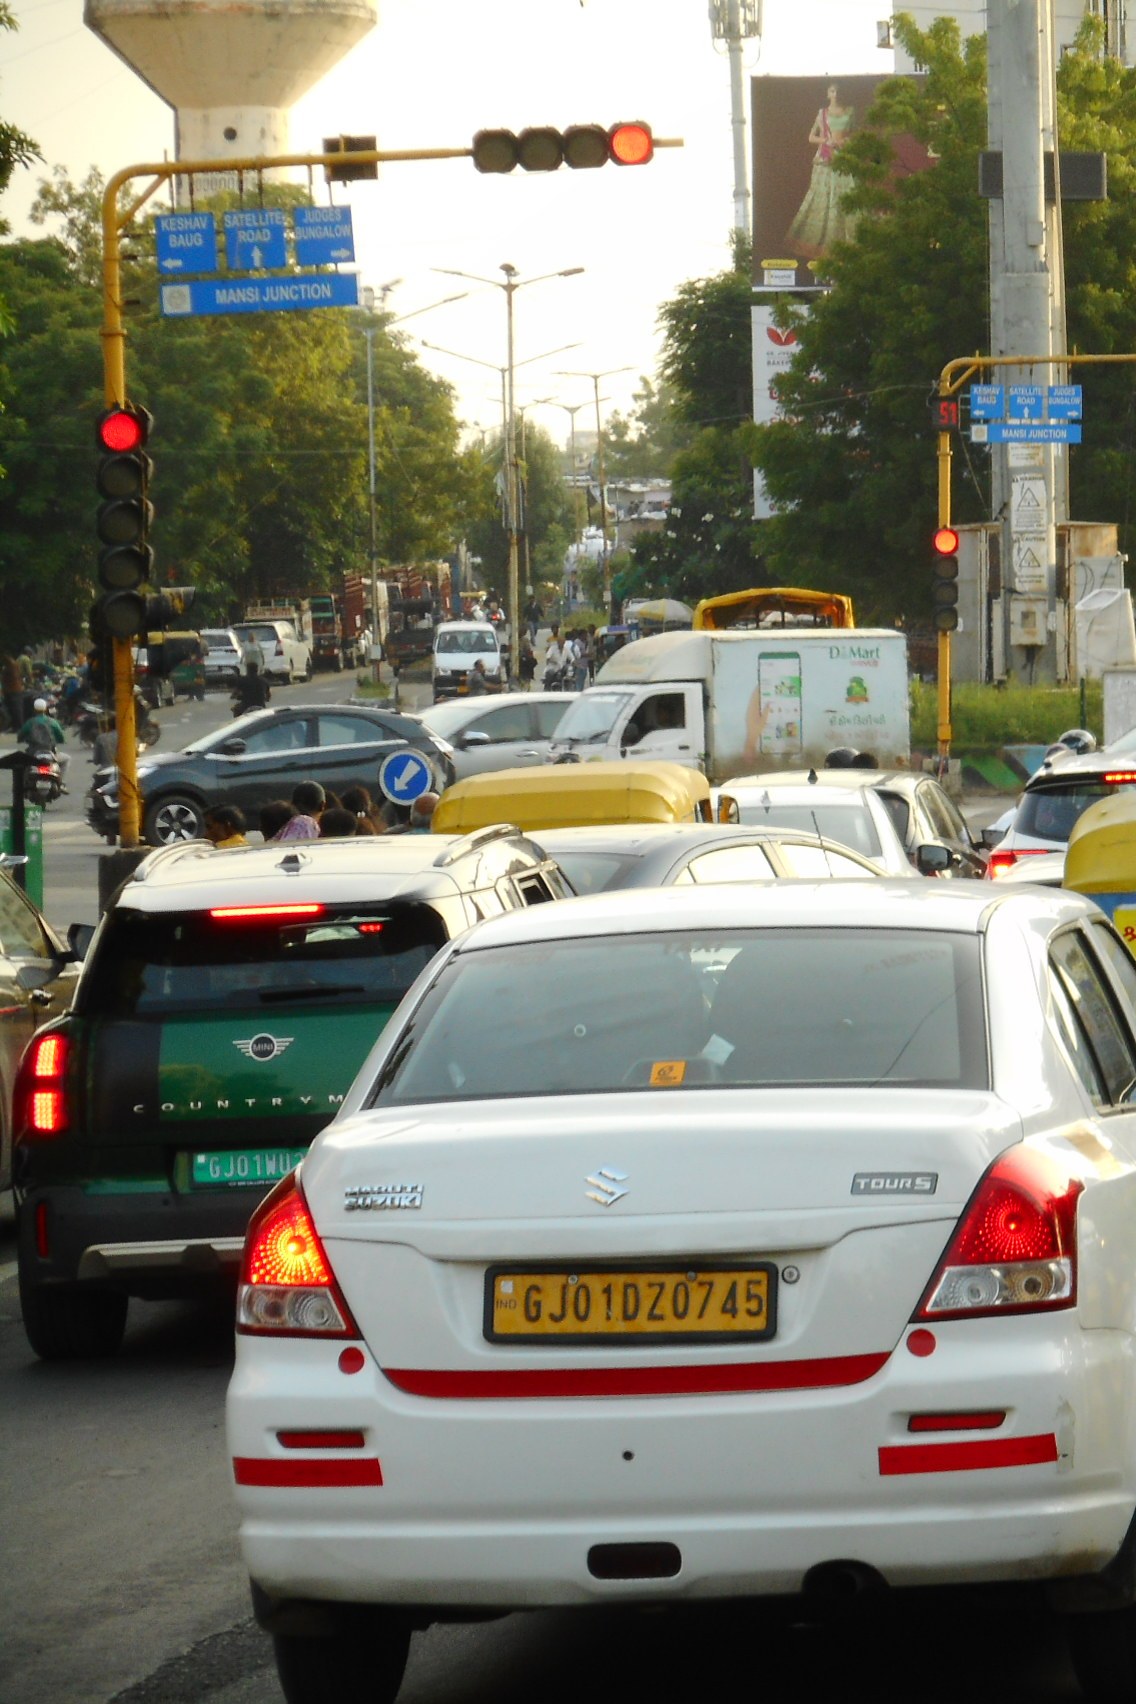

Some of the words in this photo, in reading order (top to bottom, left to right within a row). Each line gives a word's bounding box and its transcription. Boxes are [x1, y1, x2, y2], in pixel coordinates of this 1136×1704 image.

[224, 211, 283, 228] SATELLITE
[303, 208, 342, 222] JUDGES
[161, 217, 208, 232] KESHAV
[296, 224, 351, 240] BUNGALOW
[169, 233, 203, 248] BAUG
[238, 230, 271, 243] ROAD
[215, 289, 260, 305] MANSI
[263, 284, 332, 302] JUNCTION
[1017, 396, 1036, 405] ROAD
[939, 401, 958, 425] 51
[1002, 428, 1027, 438] MANSI
[1028, 428, 1068, 439] JUNCTION
[252, 1043, 274, 1052] MINI
[344, 1195, 423, 1211] SUZUKI
[495, 1299, 517, 1310] IND
[524, 1279, 765, 1323] GJ01DZ0745
